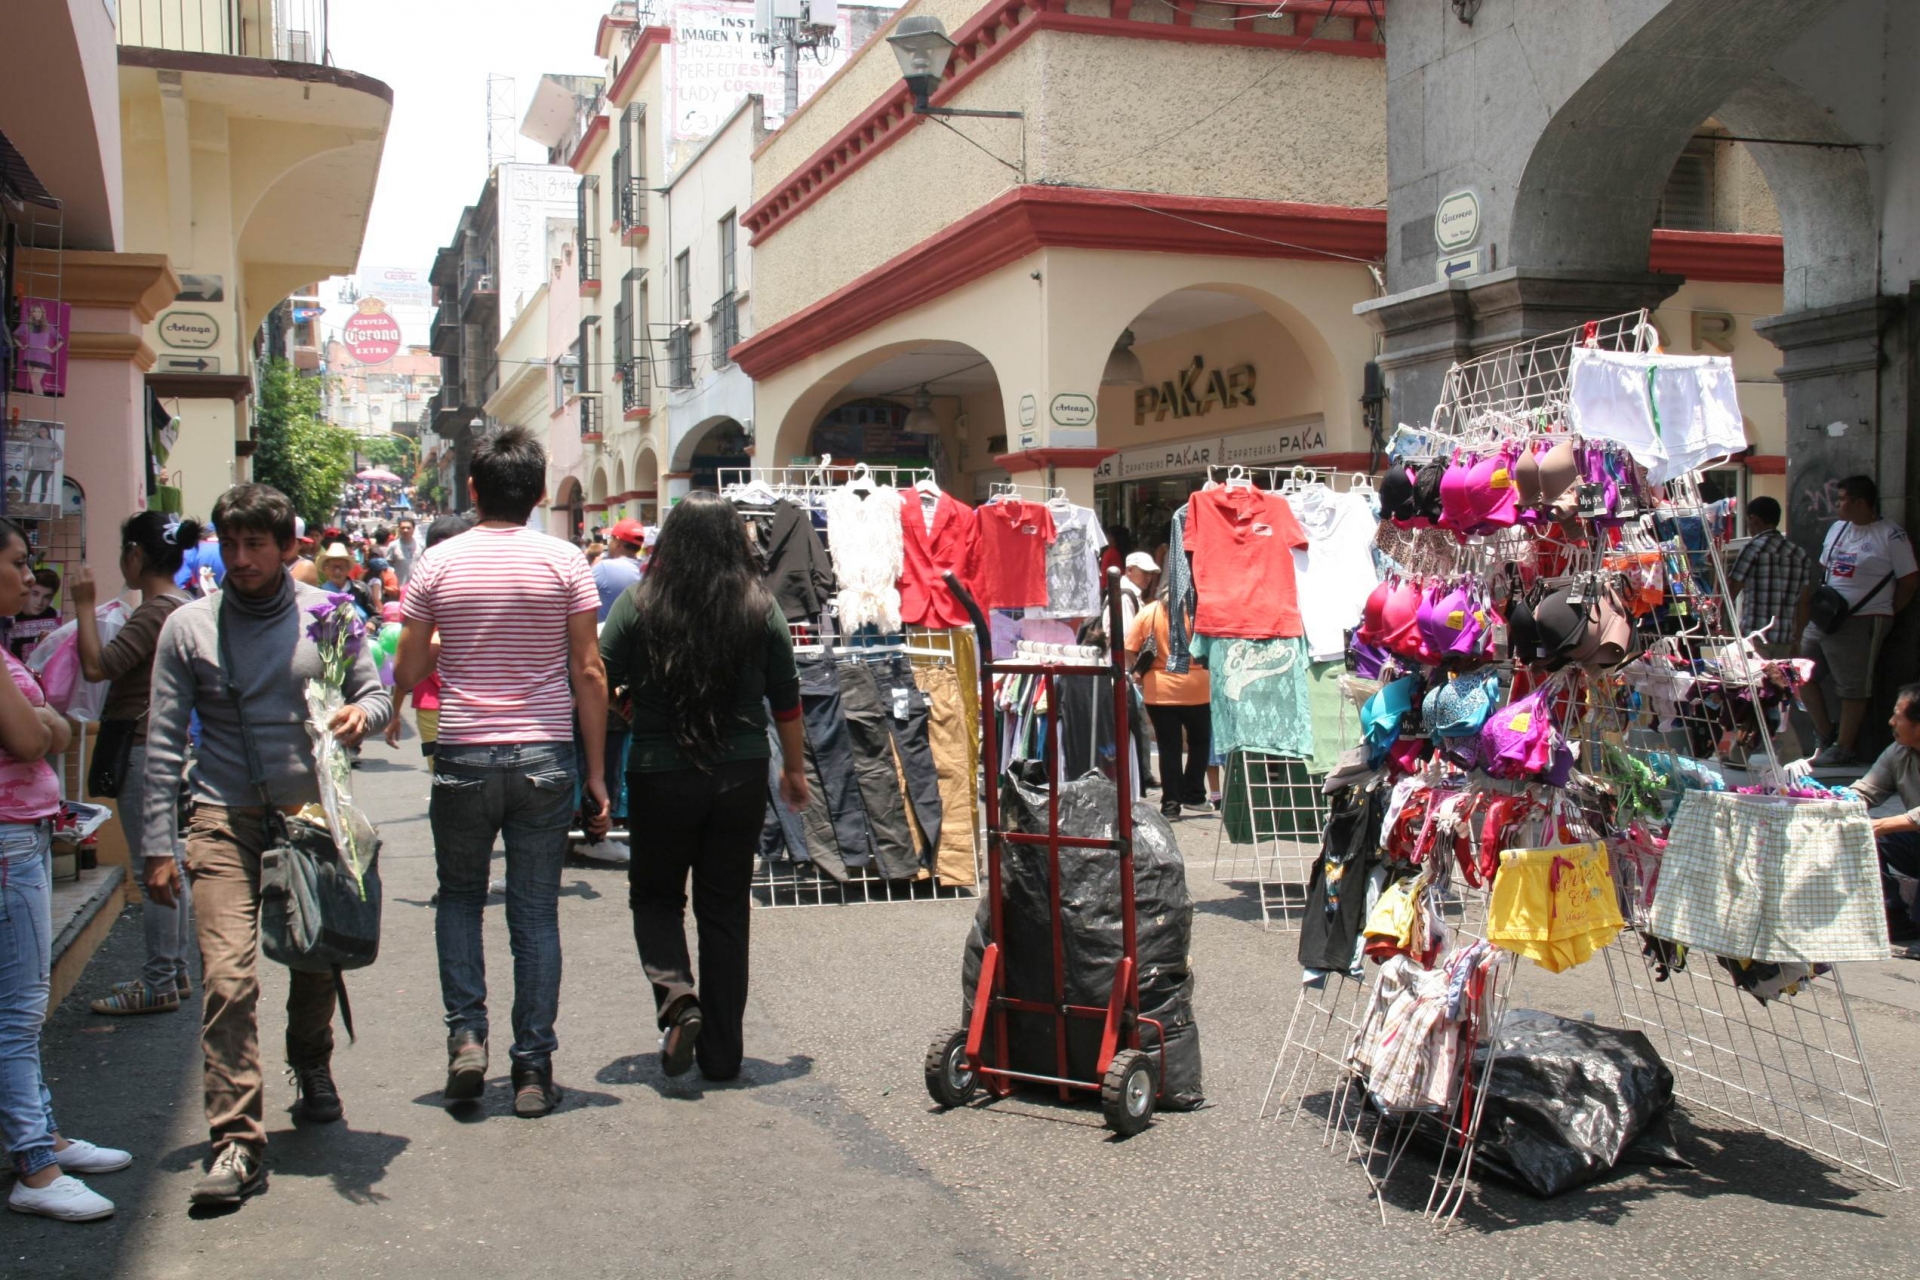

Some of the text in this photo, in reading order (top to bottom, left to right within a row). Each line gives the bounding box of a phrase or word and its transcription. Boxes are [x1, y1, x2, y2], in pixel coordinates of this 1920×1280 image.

[682, 28, 728, 42] IMAGEN
[736, 32, 743, 42] Y
[679, 63, 738, 79] PERFECT
[737, 63, 824, 80] ESTILSTA
[679, 86, 719, 103] LADY
[166, 322, 211, 334] Arteaga
[345, 327, 399, 347] Corona
[1134, 355, 1257, 426] PAKAR
[1055, 403, 1090, 413] Arteaga
[1166, 445, 1210, 468] PAKAR
[1228, 445, 1276, 460] ZAPATERIAS
[1280, 426, 1327, 453] PAKA
